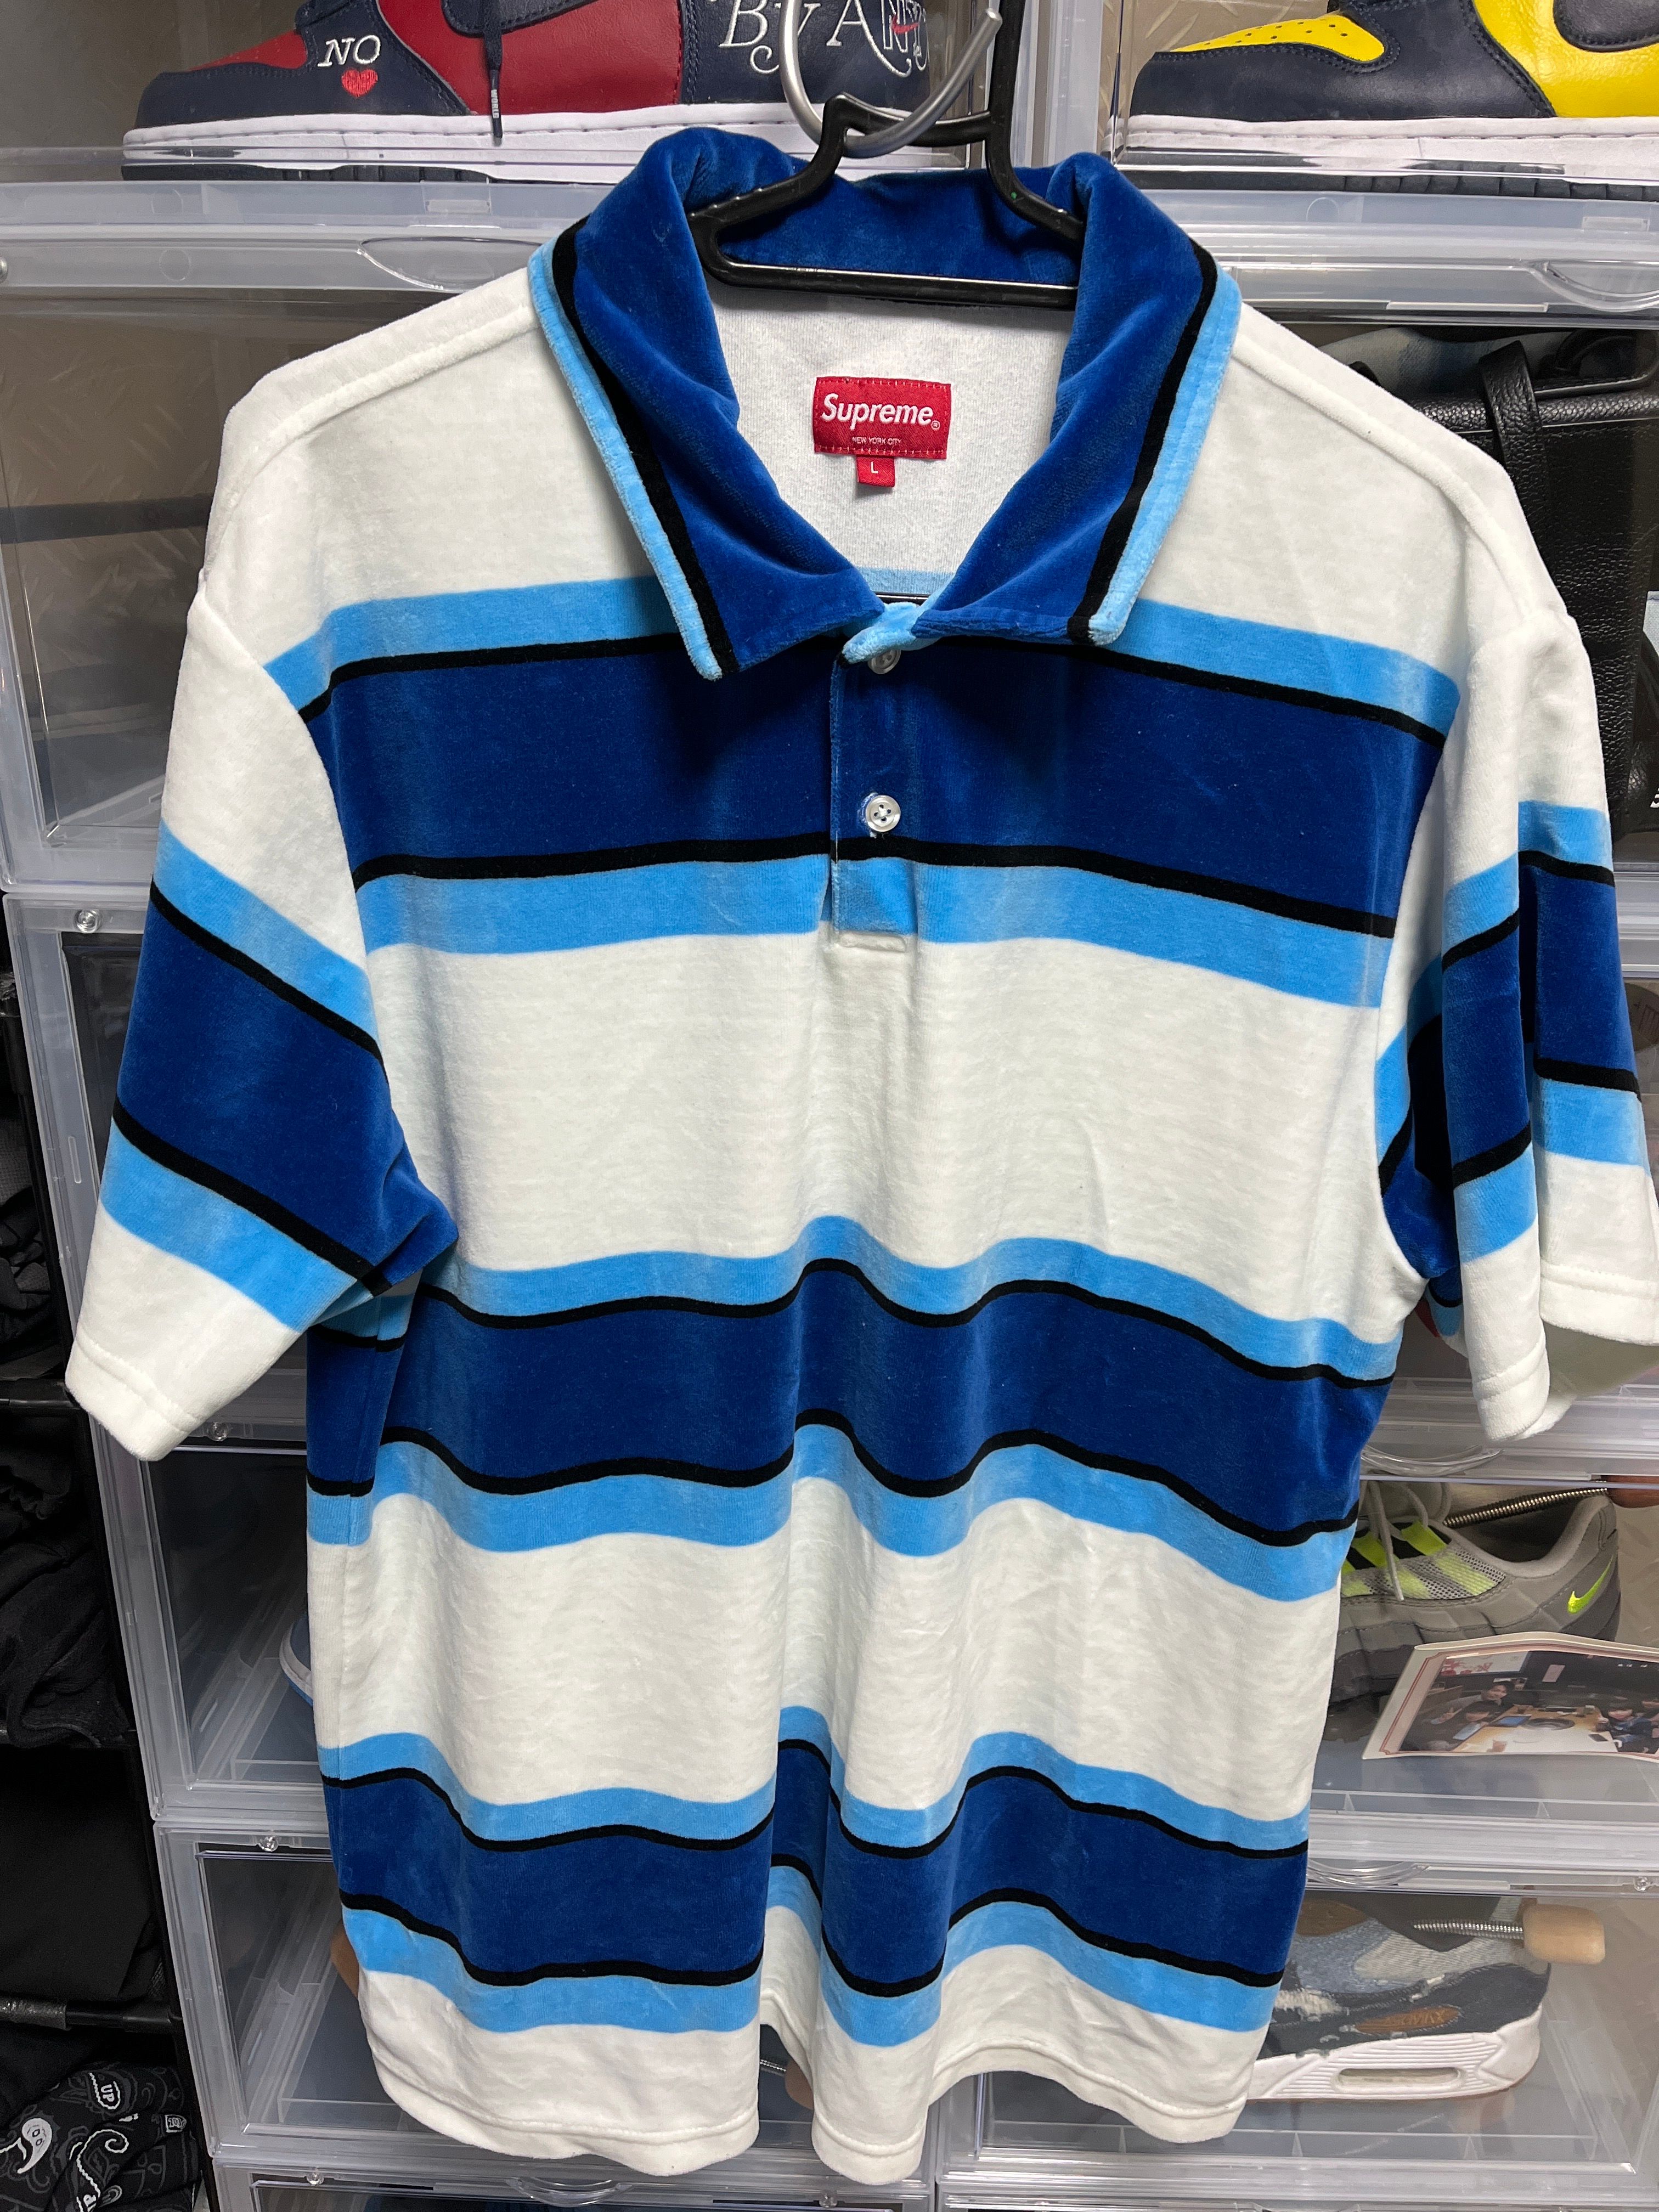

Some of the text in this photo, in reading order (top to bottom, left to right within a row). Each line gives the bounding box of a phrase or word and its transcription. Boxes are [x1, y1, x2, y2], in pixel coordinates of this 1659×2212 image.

[317, 35, 381, 67] NO
[852, 436, 867, 444] NEW
[868, 437, 887, 445] YORK
[871, 461, 879, 473] L
